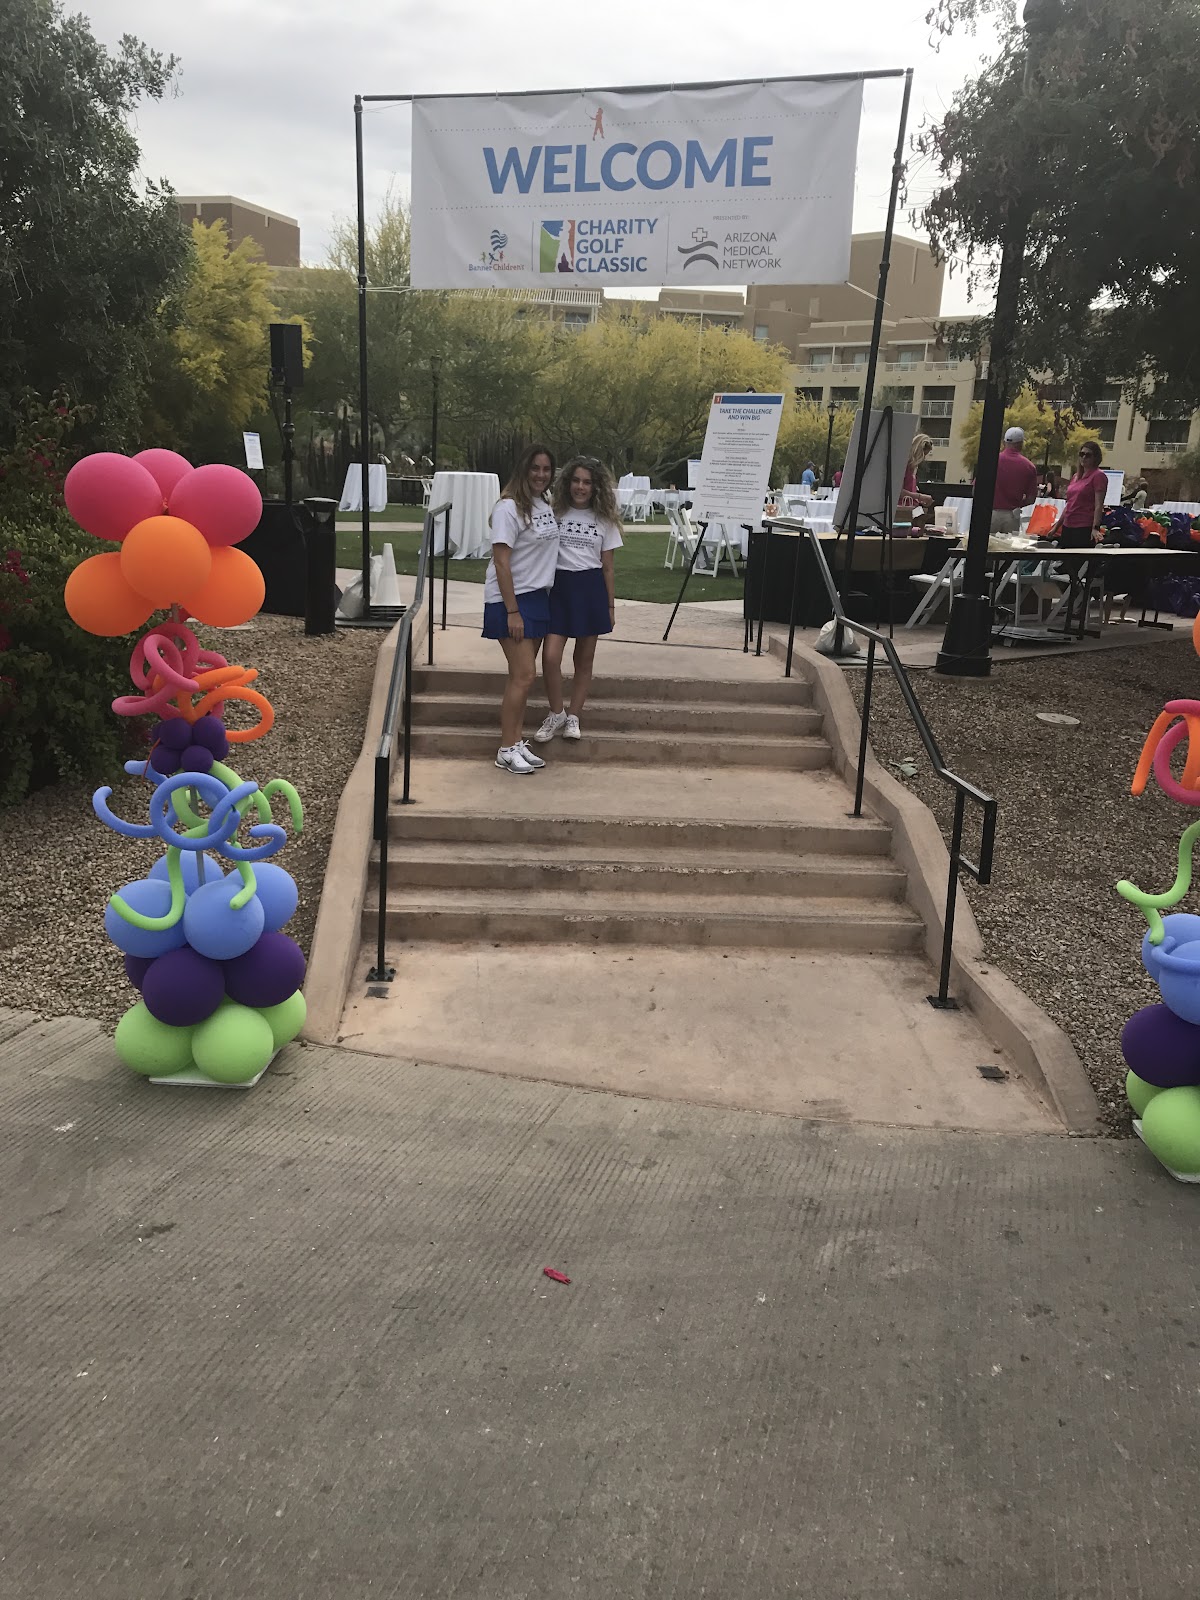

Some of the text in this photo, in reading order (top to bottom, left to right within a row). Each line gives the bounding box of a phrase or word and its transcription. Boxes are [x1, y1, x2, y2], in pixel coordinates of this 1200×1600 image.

[483, 136, 774, 195] WELCOME
[577, 218, 658, 237] CHARITY
[724, 232, 778, 243] ARIZONA
[576, 238, 624, 255] GOLF
[723, 245, 774, 256] MEDICAL
[468, 264, 493, 272] Banner
[575, 256, 648, 273] CLASSIC
[722, 258, 782, 269] NETWORK
